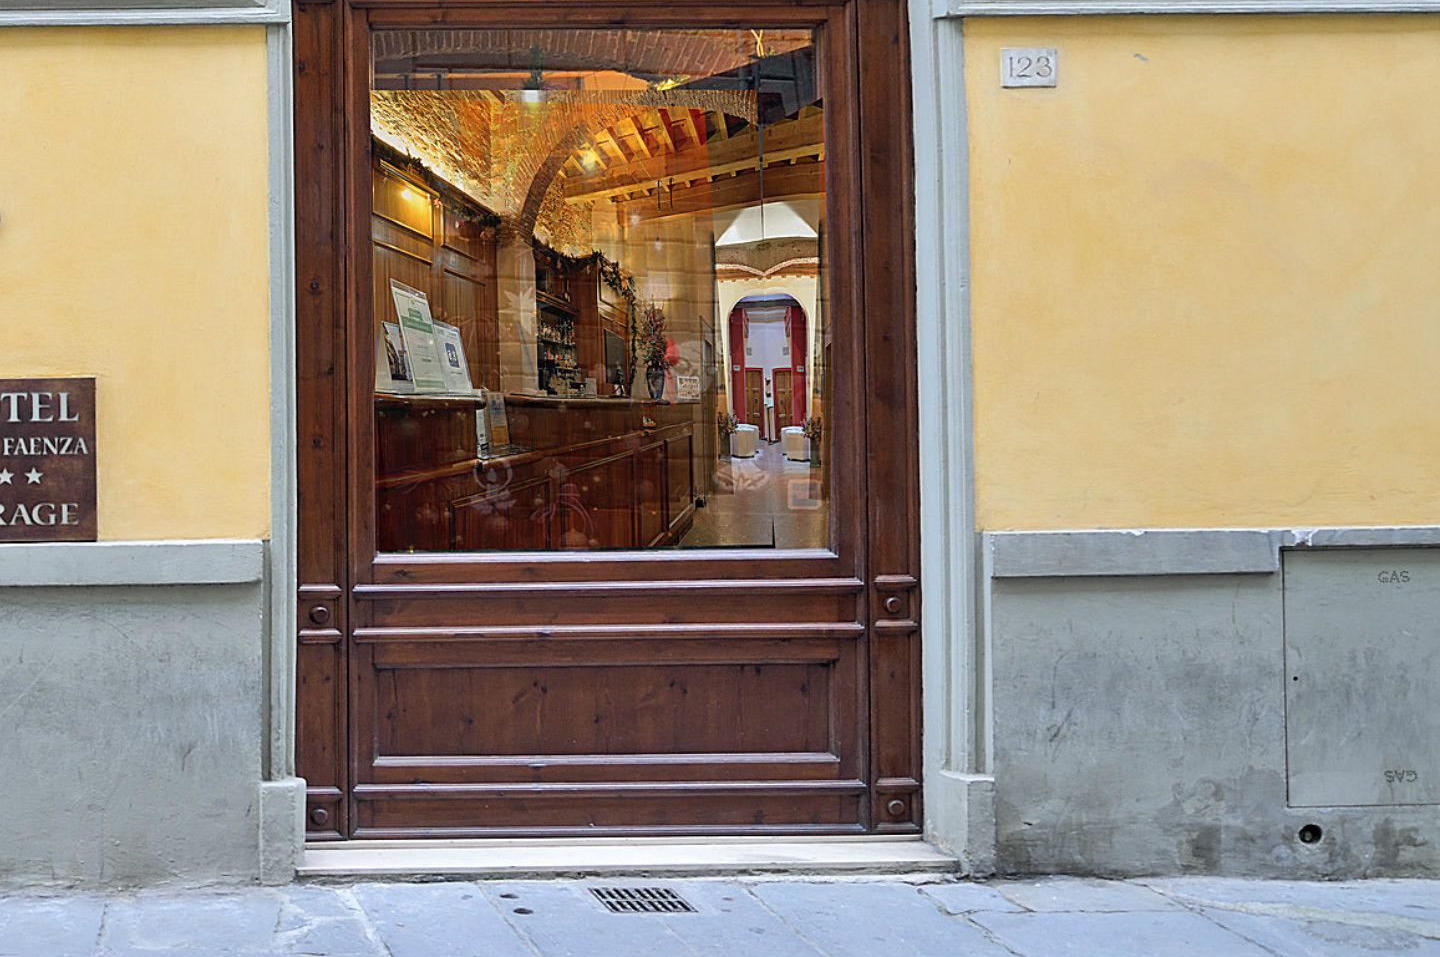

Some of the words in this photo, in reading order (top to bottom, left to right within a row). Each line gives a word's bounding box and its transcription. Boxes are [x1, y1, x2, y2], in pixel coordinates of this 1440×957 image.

[1008, 55, 1053, 79] 123
[2, 436, 89, 456] FAENZA
[1377, 569, 1411, 584] GAS
[1383, 769, 1418, 784] GAS
